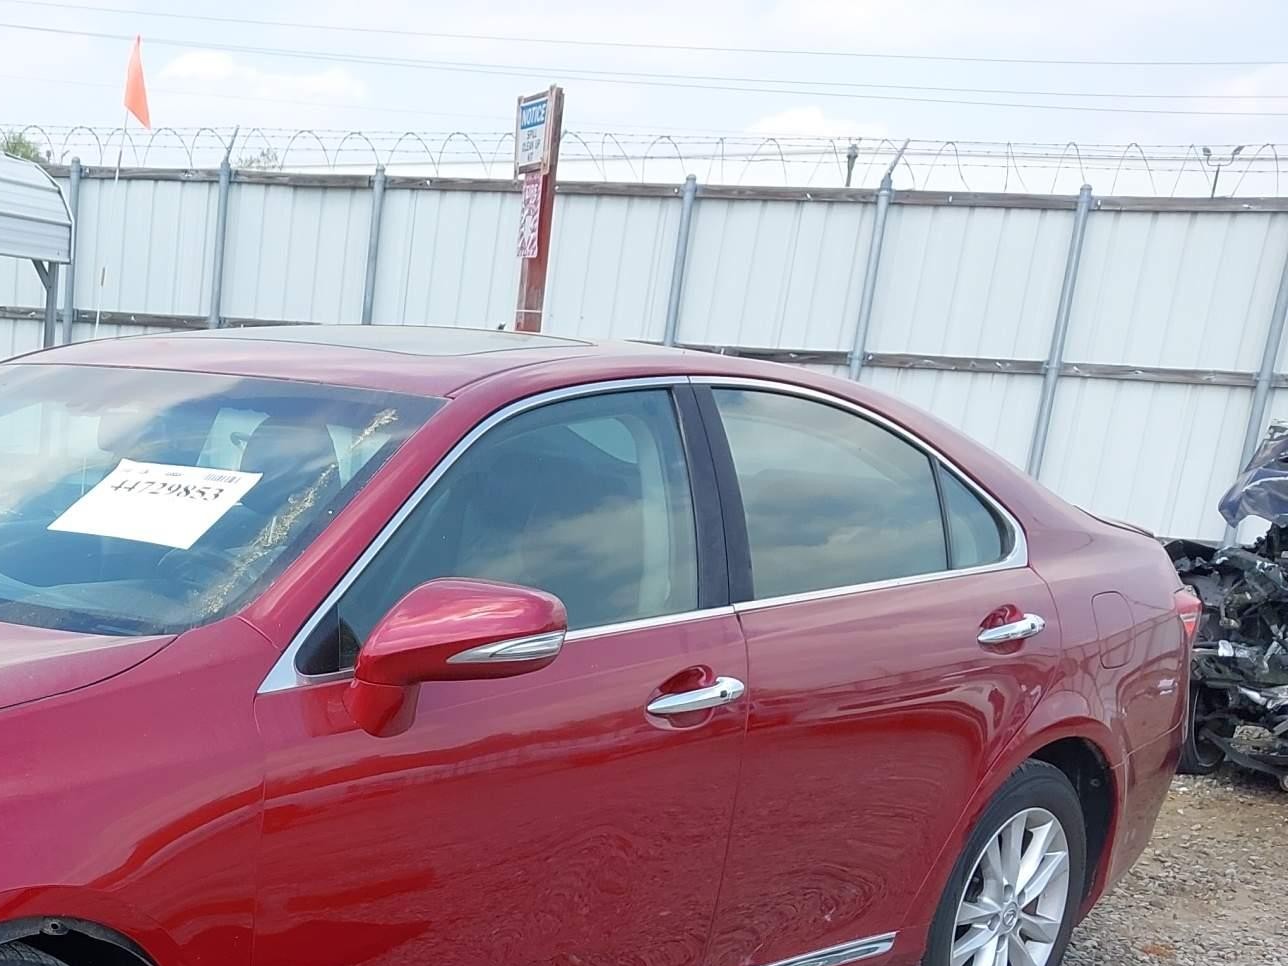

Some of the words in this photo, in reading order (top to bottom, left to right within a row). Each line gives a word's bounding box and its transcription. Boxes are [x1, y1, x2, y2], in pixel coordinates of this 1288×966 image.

[521, 105, 546, 127] NOTICE
[526, 130, 537, 139] SPILL
[522, 140, 534, 151] CLEAN
[534, 138, 541, 149] UP
[110, 480, 225, 501] 44729853
